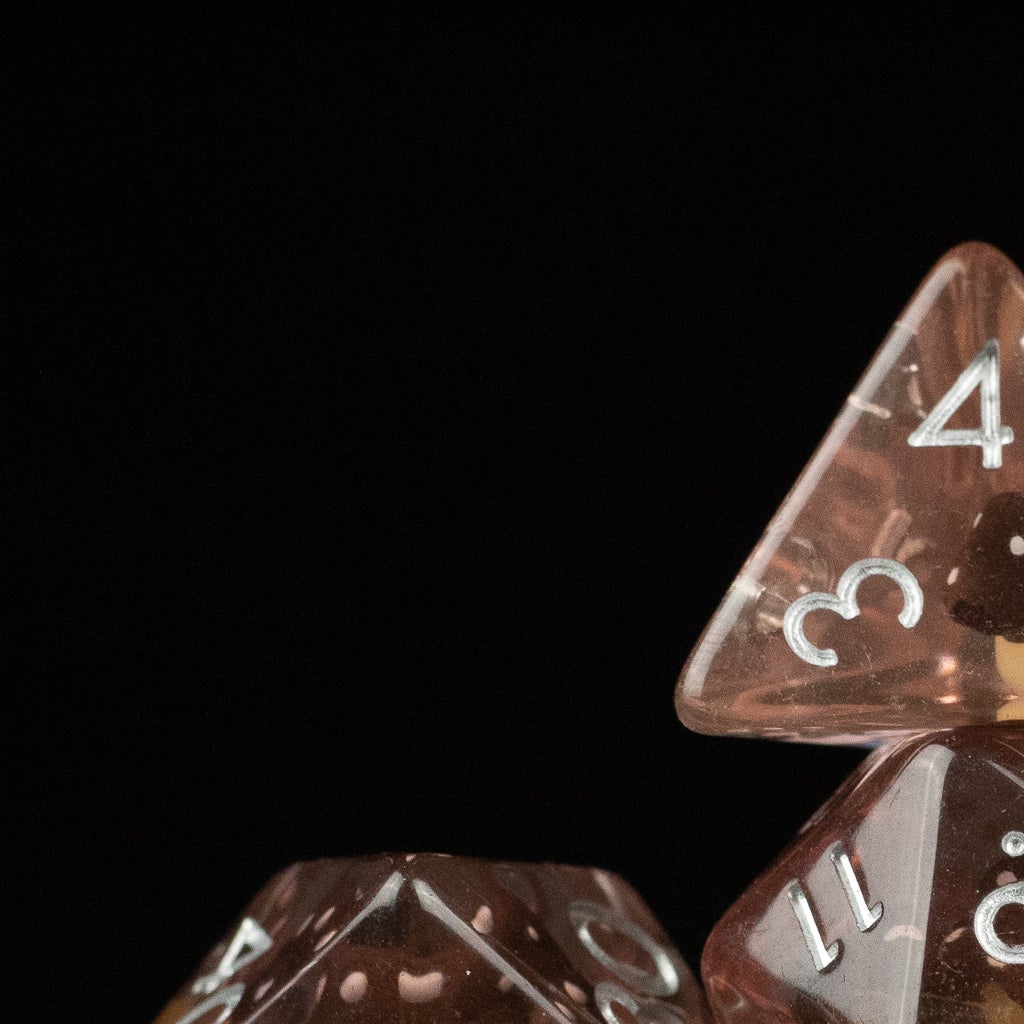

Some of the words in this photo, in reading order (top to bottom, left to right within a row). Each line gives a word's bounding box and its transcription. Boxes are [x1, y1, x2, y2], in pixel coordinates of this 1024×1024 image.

[908, 338, 1014, 469] 4
[783, 557, 924, 667] 3
[786, 840, 885, 973] 11
